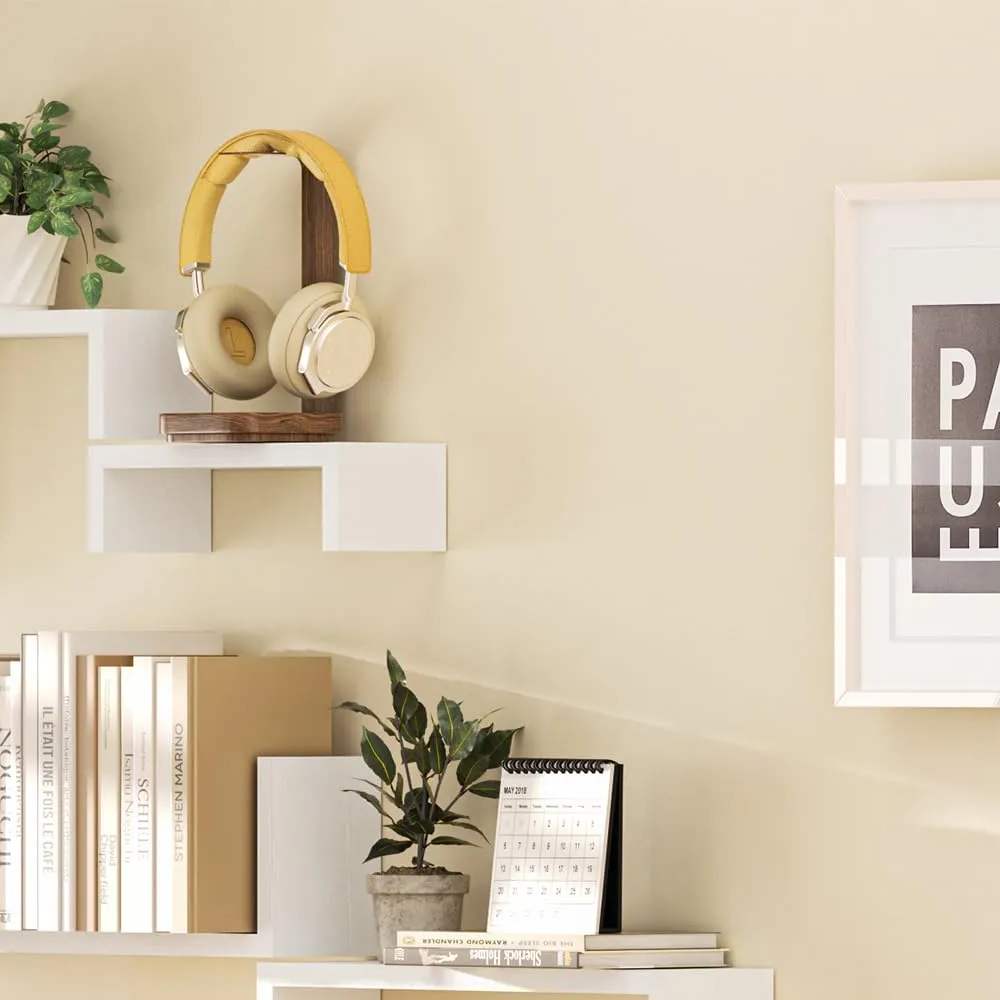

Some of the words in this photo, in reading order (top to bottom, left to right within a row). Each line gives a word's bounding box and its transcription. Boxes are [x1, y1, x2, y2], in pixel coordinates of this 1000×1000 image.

[42, 706, 54, 718] IL
[42, 721, 57, 758] ÉTAIT
[174, 723, 184, 787] MARINO
[42, 760, 54, 787] UNE
[122, 752, 134, 796] Isamu
[0, 728, 12, 866] NOGUCHI
[42, 790, 54, 819] FOIS
[504, 786, 514, 794] MAY
[515, 786, 528, 795] 2018
[42, 822, 54, 838] LE
[138, 778, 150, 861] SCHIELE
[174, 790, 184, 862] STEPHEN
[42, 841, 57, 873] CAFÉ
[108, 834, 117, 867] David
[469, 949, 501, 965] Holmes
[504, 950, 542, 966] Sherlock
